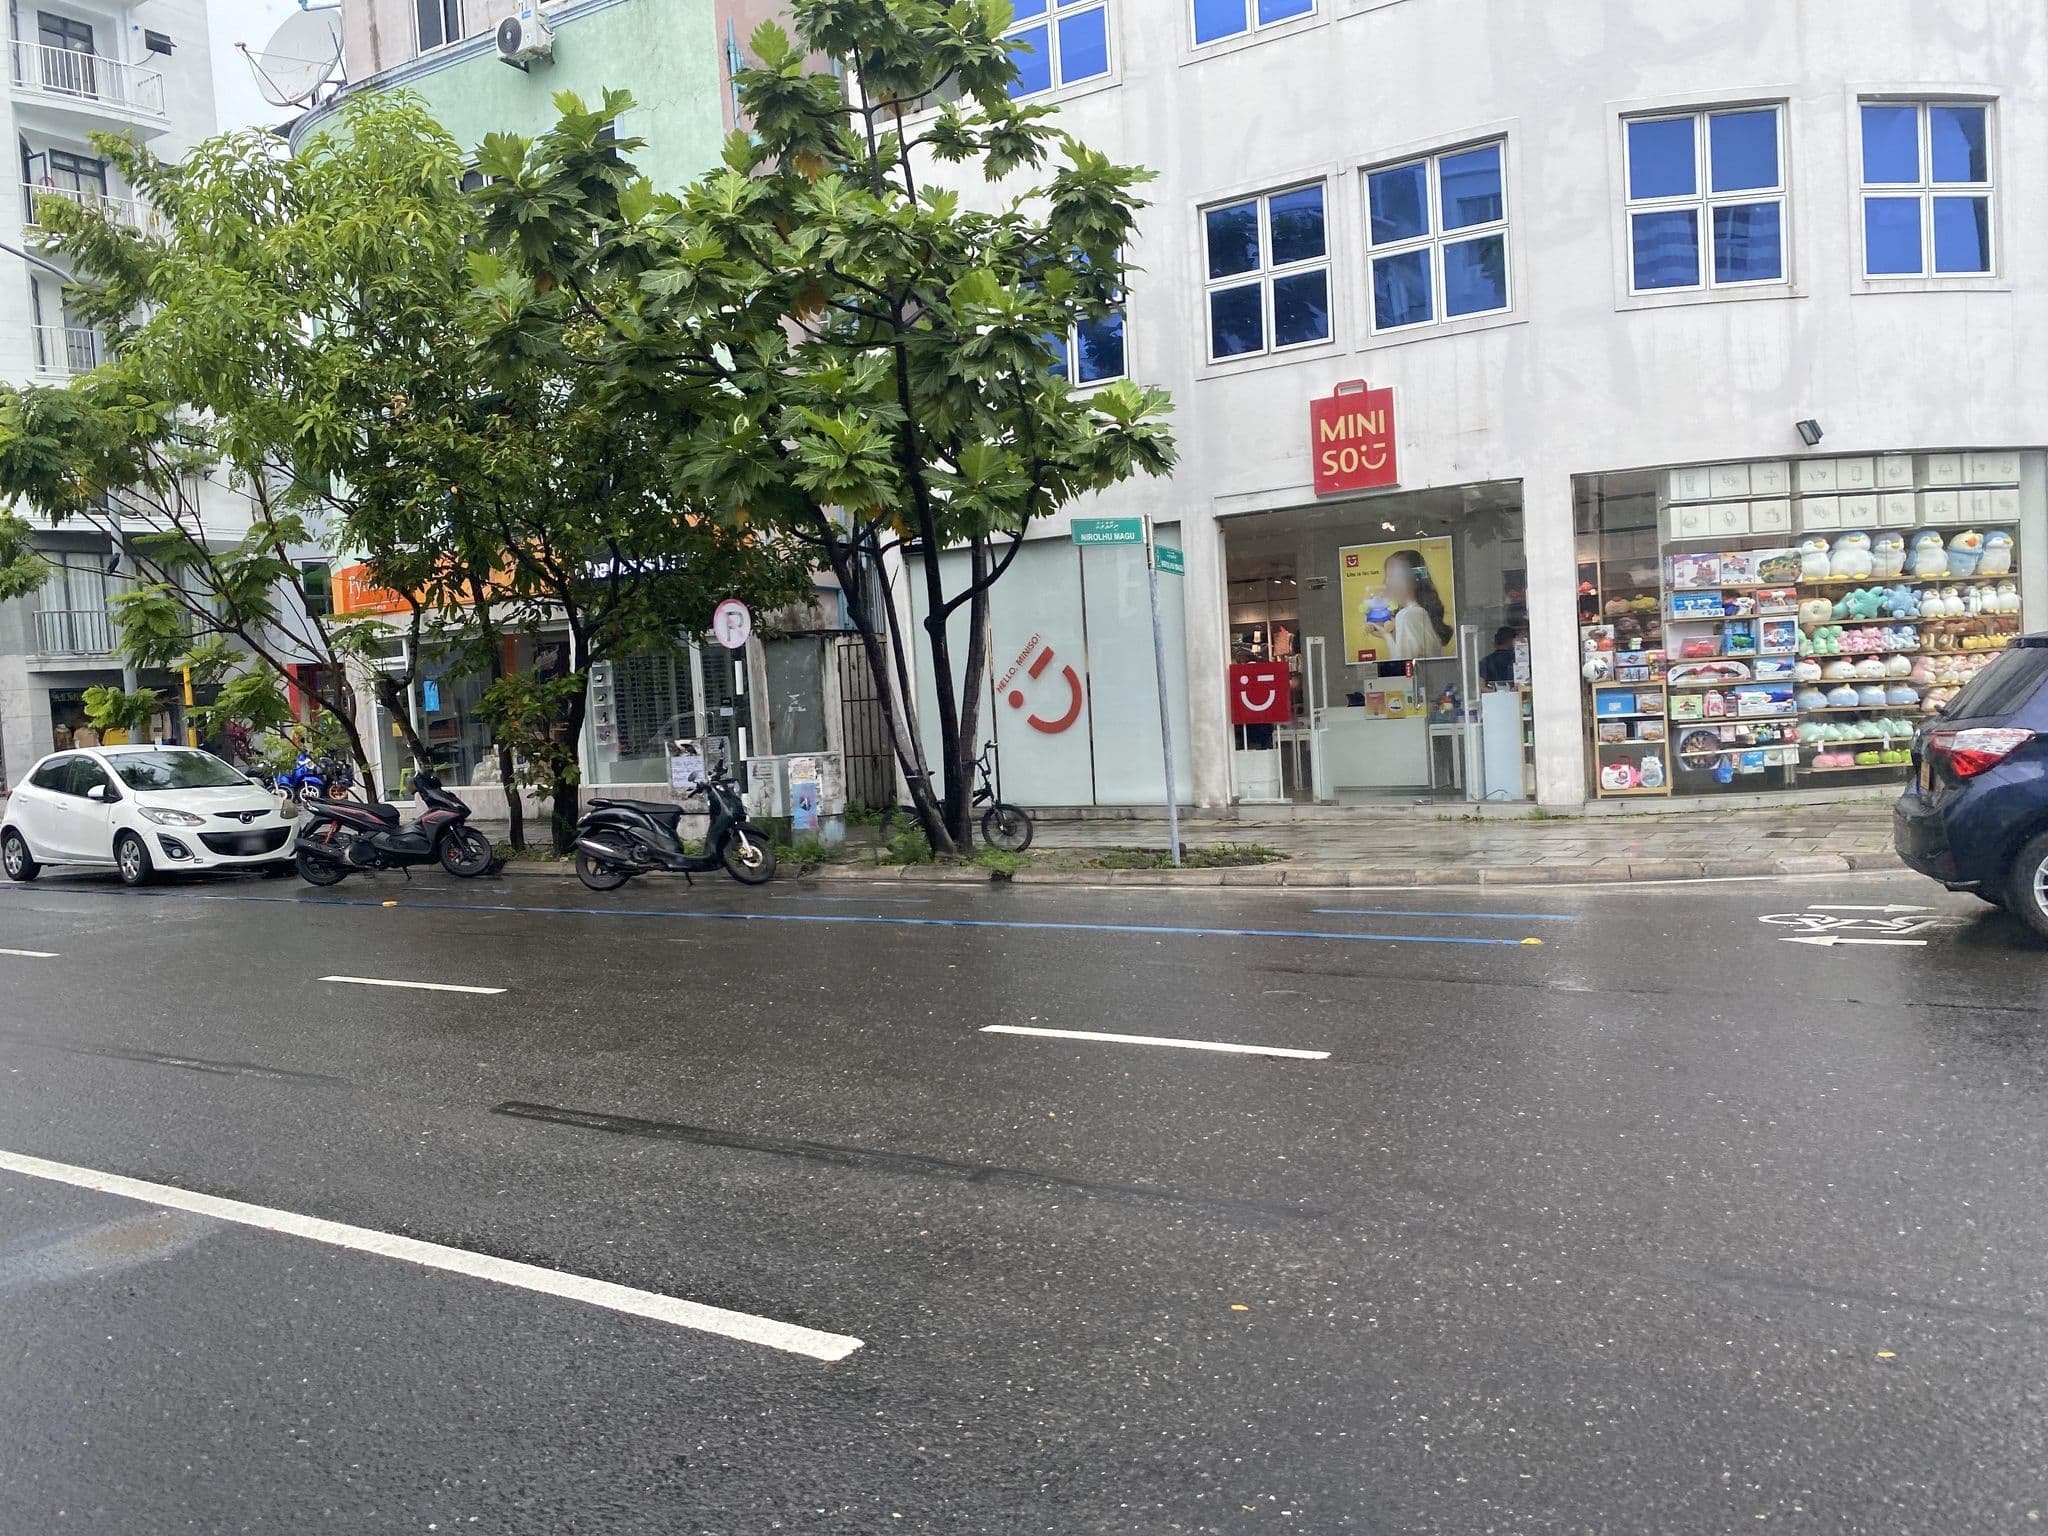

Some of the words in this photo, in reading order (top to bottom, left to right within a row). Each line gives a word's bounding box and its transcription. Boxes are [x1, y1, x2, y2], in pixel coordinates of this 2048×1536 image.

[1320, 409, 1385, 443] MINI
[1080, 532, 1112, 541] NIROLHU
[1113, 532, 1135, 540] MAGU
[725, 611, 744, 642] P
[996, 667, 1019, 693] HELLO,
[1015, 633, 1041, 666] MINISO!
